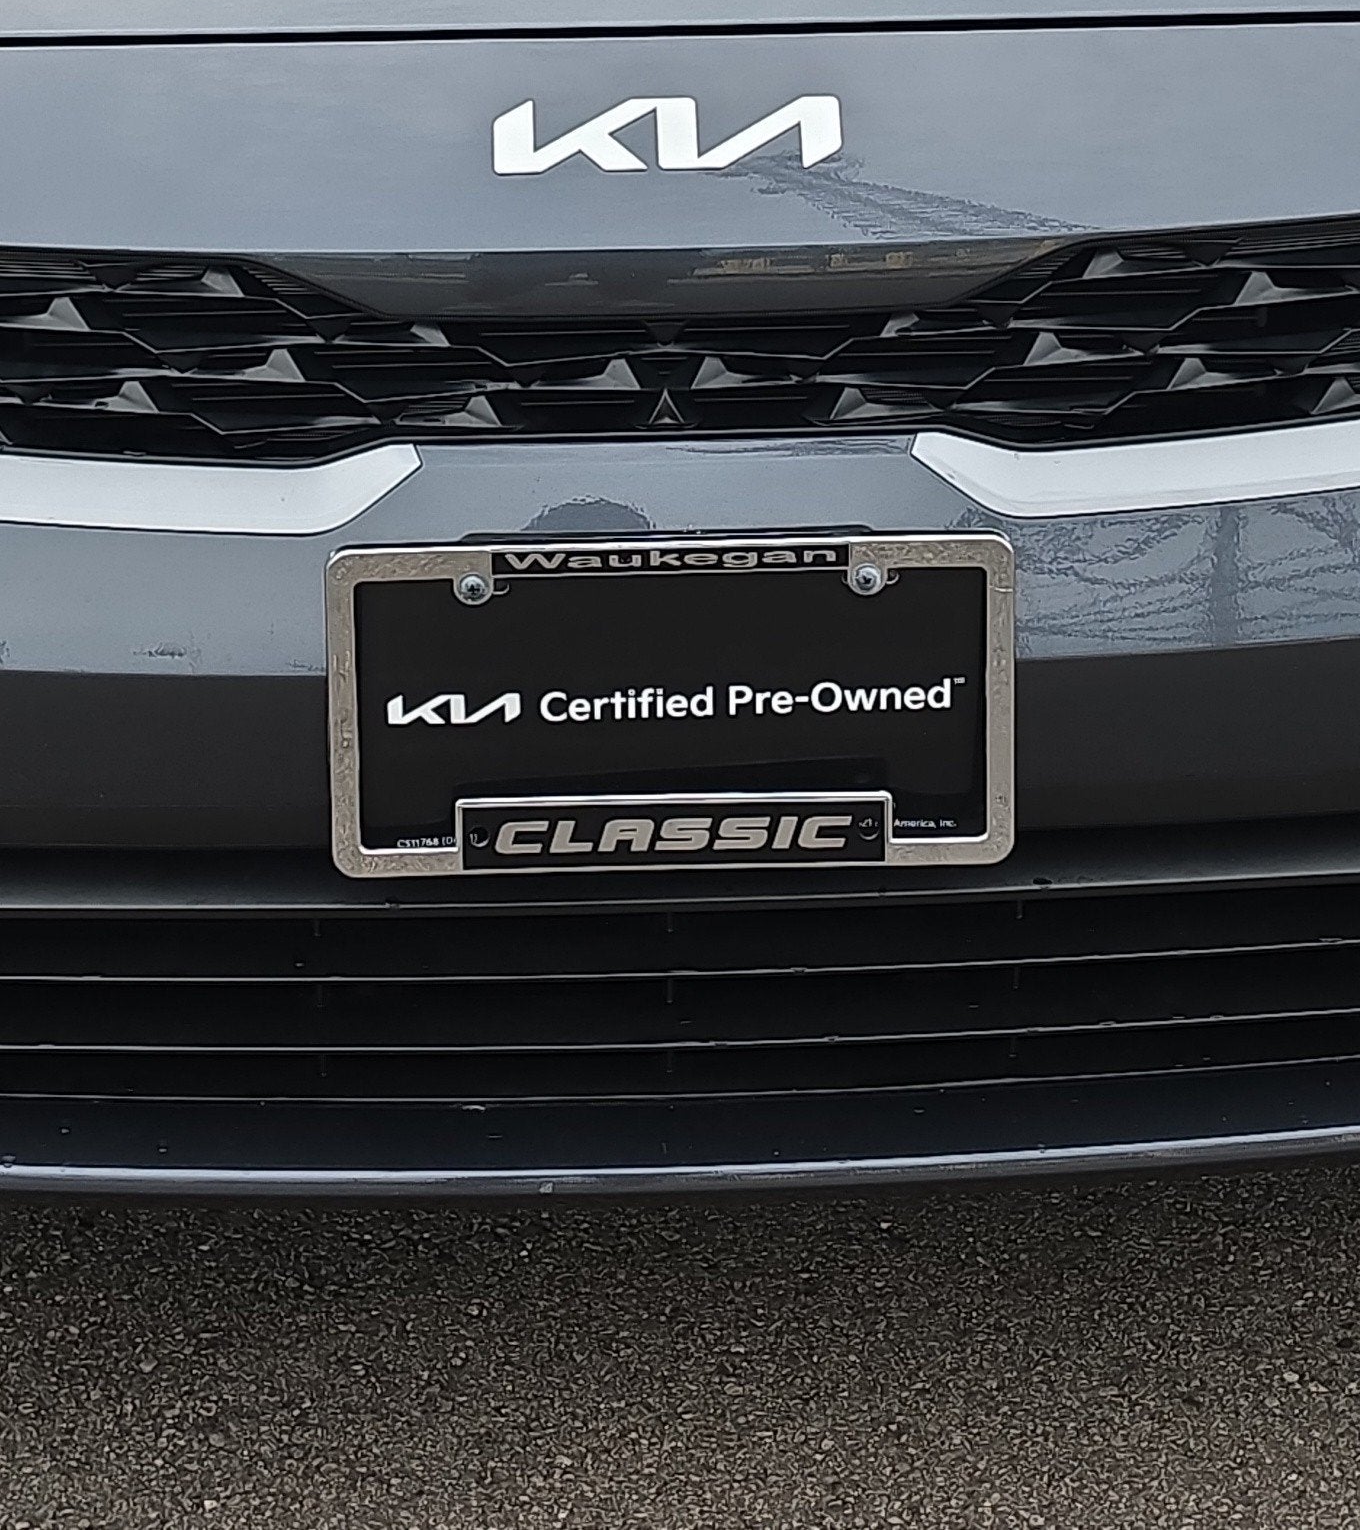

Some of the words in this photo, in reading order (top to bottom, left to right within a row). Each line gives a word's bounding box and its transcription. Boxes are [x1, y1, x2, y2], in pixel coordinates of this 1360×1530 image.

[492, 94, 842, 176] KIA
[504, 548, 837, 570] Waukegan
[386, 692, 521, 725] KIA
[540, 685, 714, 722] Certified
[495, 815, 853, 854] CLASSIC
